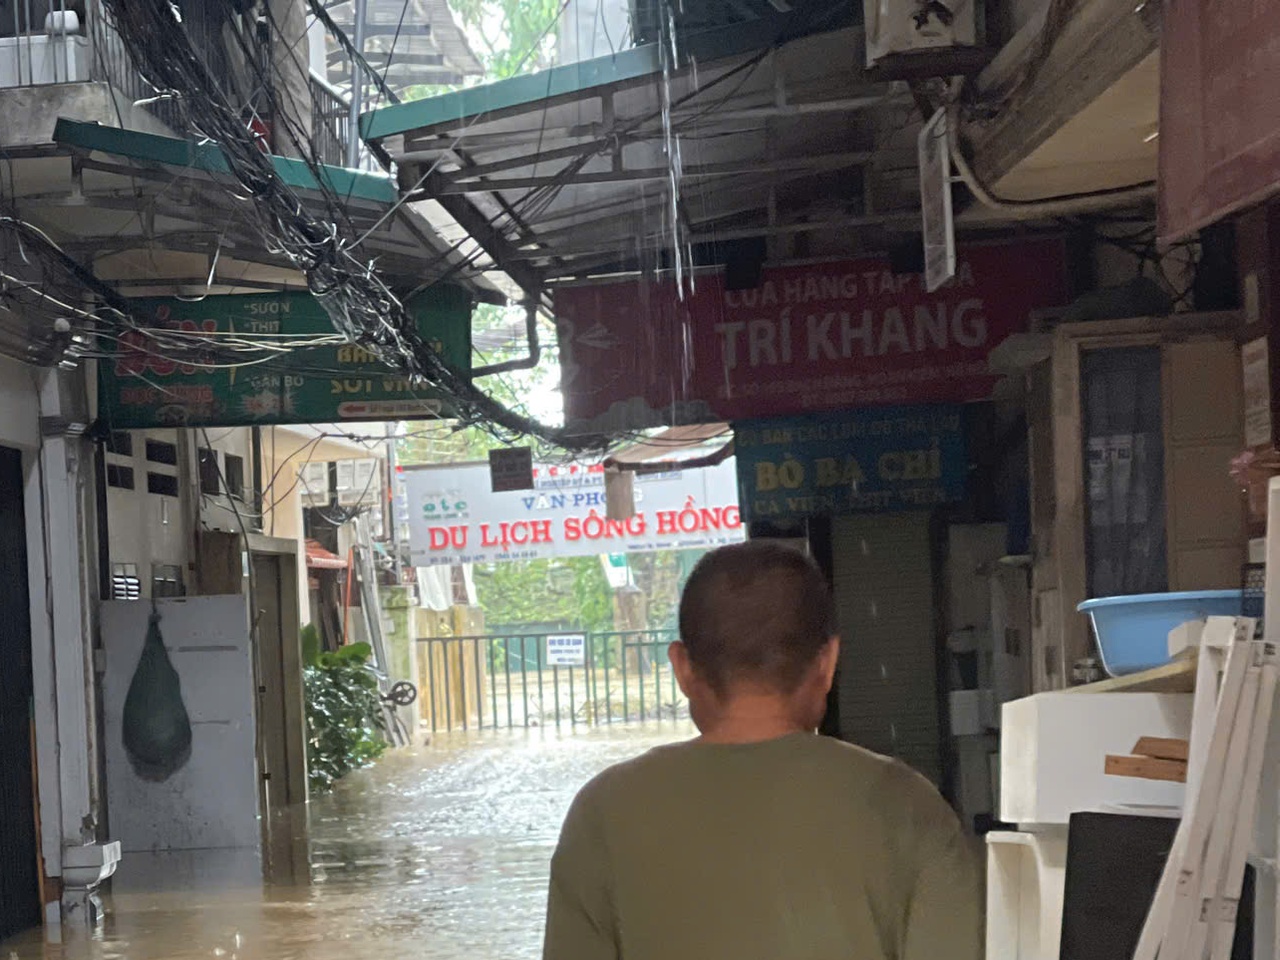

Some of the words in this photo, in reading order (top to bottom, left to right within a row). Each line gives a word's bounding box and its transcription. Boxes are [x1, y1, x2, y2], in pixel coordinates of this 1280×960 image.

[714, 305, 793, 370] TRÍ
[806, 297, 989, 361] KHANG
[427, 525, 470, 551] DU
[479, 519, 554, 552] LỊCH
[563, 508, 647, 542] SÔNG
[655, 495, 742, 536] HỒNG
[521, 492, 565, 510] VĂN
